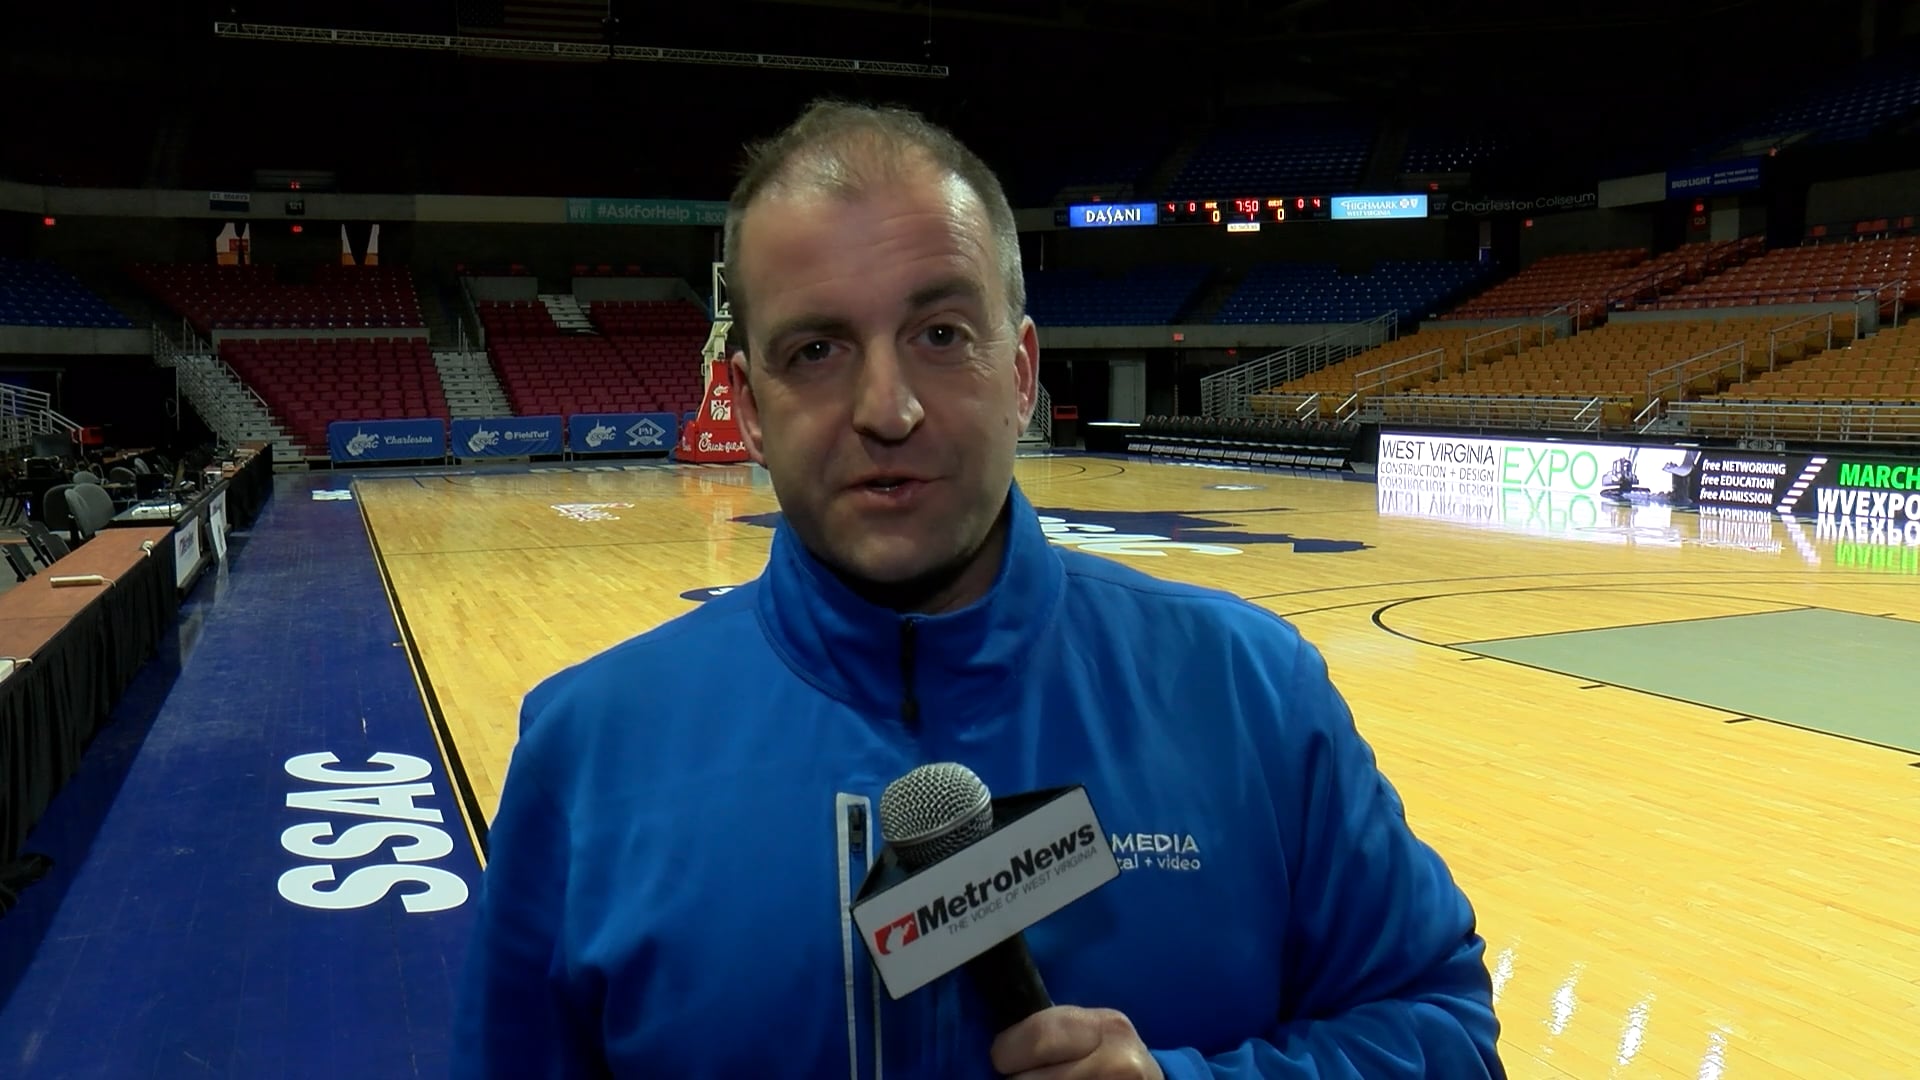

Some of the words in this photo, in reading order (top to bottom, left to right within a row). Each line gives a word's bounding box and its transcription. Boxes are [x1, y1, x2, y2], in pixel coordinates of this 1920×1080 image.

[1671, 180, 1688, 189] BUD
[1688, 176, 1711, 187] LIGHT
[1235, 200, 1259, 213] 7:50
[1345, 200, 1398, 210] HIGHMARK
[1451, 199, 1534, 213] Charleston
[1535, 191, 1596, 209] Coliseum
[597, 204, 690, 222] #AskForHelp
[1085, 206, 1141, 225] DASANI
[1212, 210, 1220, 223] 0
[1277, 208, 1285, 221] 0
[383, 433, 433, 446] Charleston
[513, 430, 550, 440] FieldTurf
[1382, 440, 1425, 461] WEST
[1429, 442, 1495, 466] VIRGINIA
[1379, 461, 1447, 480] CONSTRUCTION
[1459, 466, 1494, 482] DESIGN
[1502, 446, 1599, 491] EXPO
[1701, 458, 1721, 472] free
[1721, 460, 1787, 476] NETWORKING
[1700, 473, 1720, 486] free
[1720, 475, 1775, 490] EDUCATION
[1838, 463, 1920, 490] MARCH
[1699, 487, 1718, 500] free
[1718, 490, 1773, 505] ADMISSION
[1816, 487, 1920, 522] WVEXPO
[277, 750, 470, 914] SSAC
[1111, 833, 1200, 853] MEDIA
[1156, 854, 1201, 870] video
[916, 824, 1096, 936] MetroNews
[947, 918, 970, 935] THE
[971, 901, 1003, 923] VOICE
[1006, 891, 1020, 905] OF
[1021, 873, 1051, 896] WEST
[1053, 846, 1098, 876] VIRGINIA
